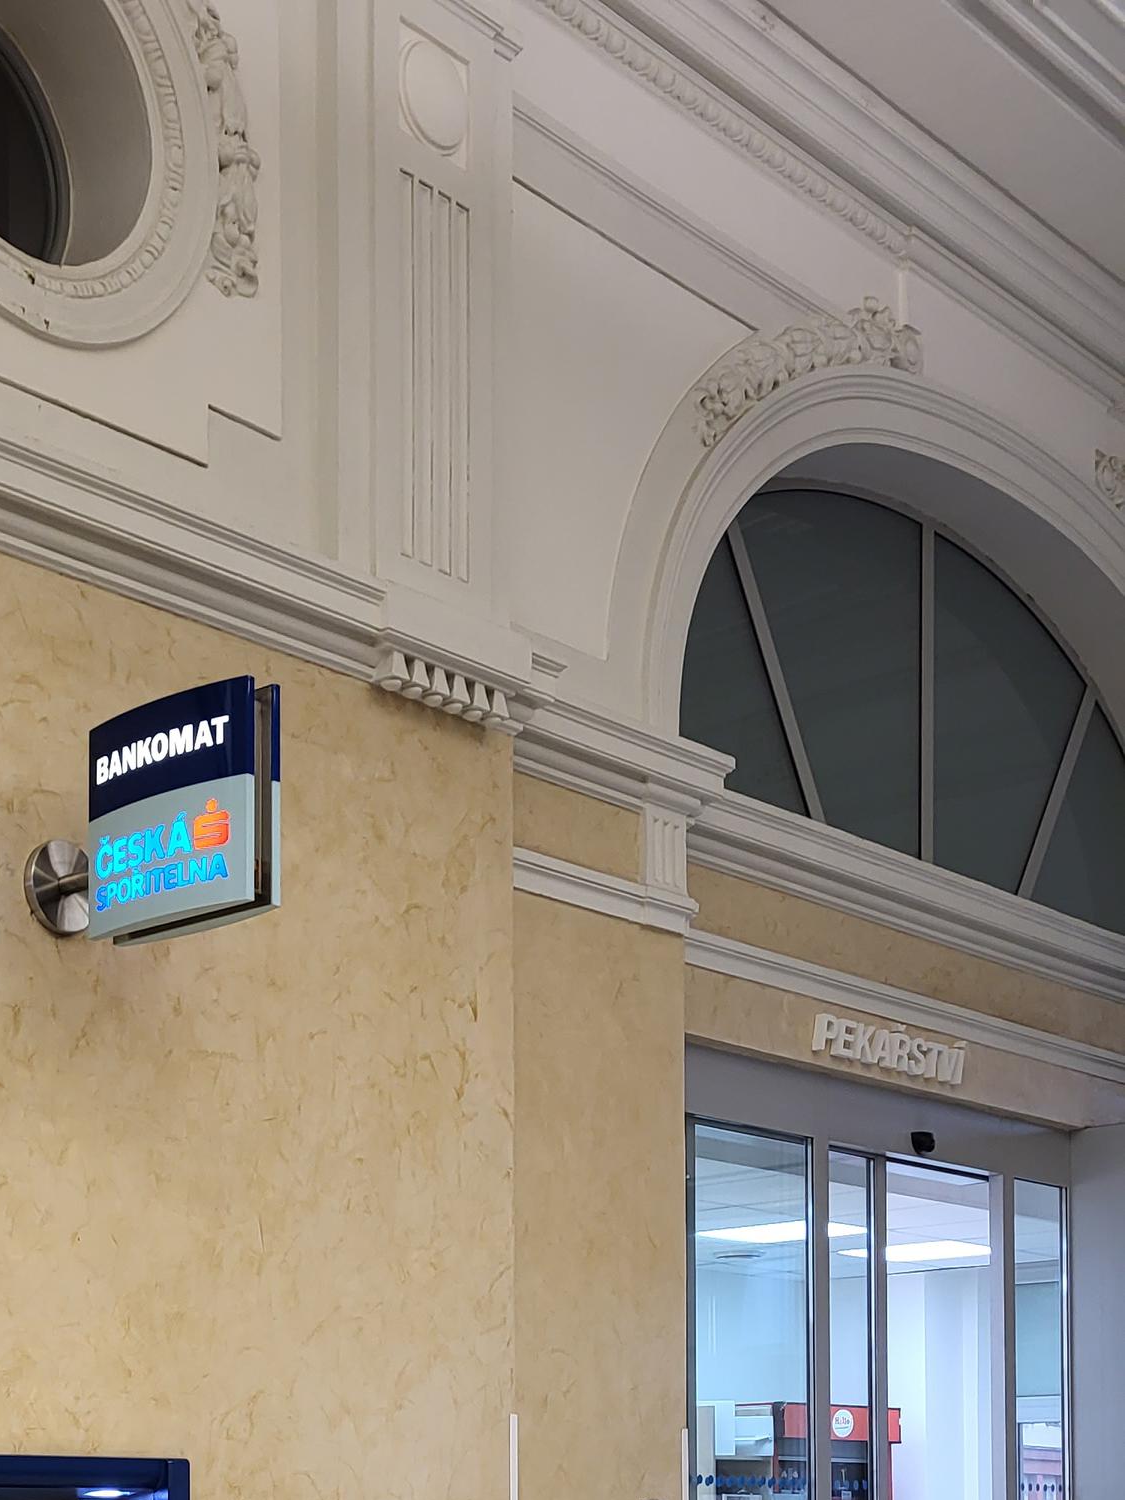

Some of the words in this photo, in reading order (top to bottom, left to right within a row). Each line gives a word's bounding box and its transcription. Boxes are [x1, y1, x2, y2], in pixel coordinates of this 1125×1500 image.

[95, 715, 230, 785] BANKOMAT
[94, 811, 193, 880] ČESKÁ
[96, 853, 228, 912] SPOŘITELNA
[812, 1013, 968, 1084] PEKAŘSTVÍ
